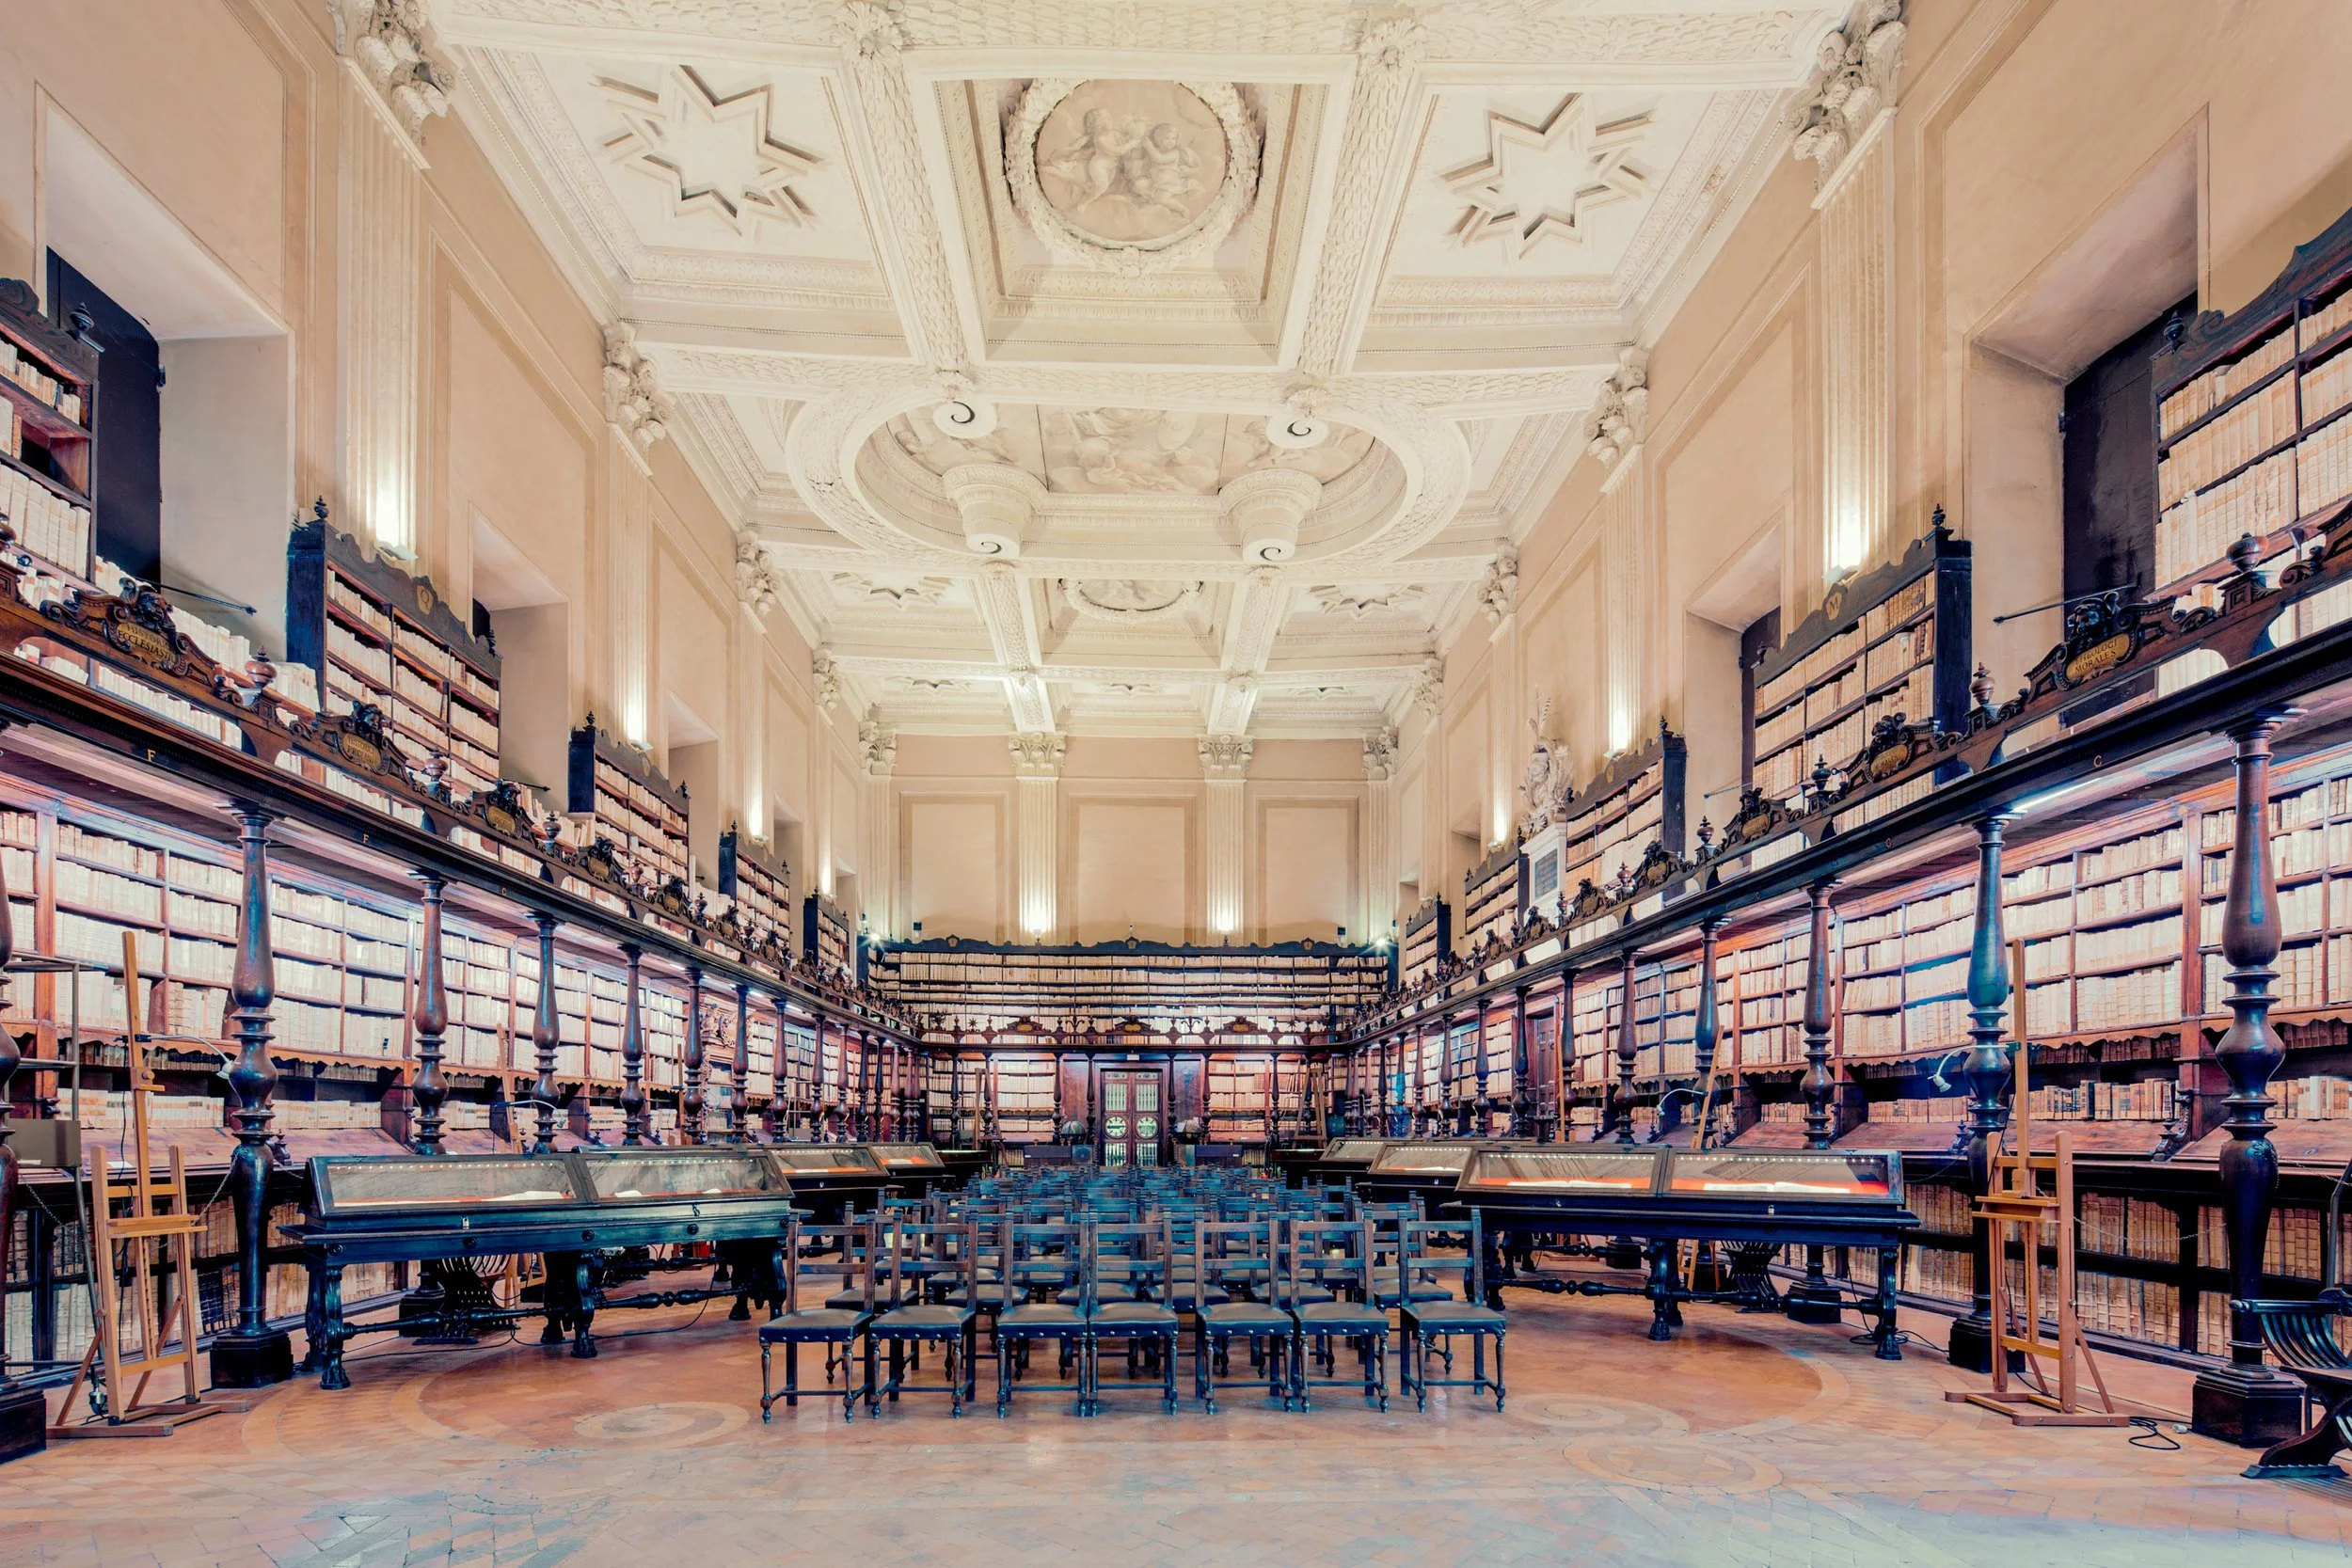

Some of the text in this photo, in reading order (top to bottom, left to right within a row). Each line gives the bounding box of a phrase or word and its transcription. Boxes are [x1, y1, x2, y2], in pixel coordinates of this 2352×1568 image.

[2074, 649, 2117, 674] MORALES
[147, 749, 156, 762] F
[2093, 754, 2103, 768] C
[363, 833, 370, 844] F
